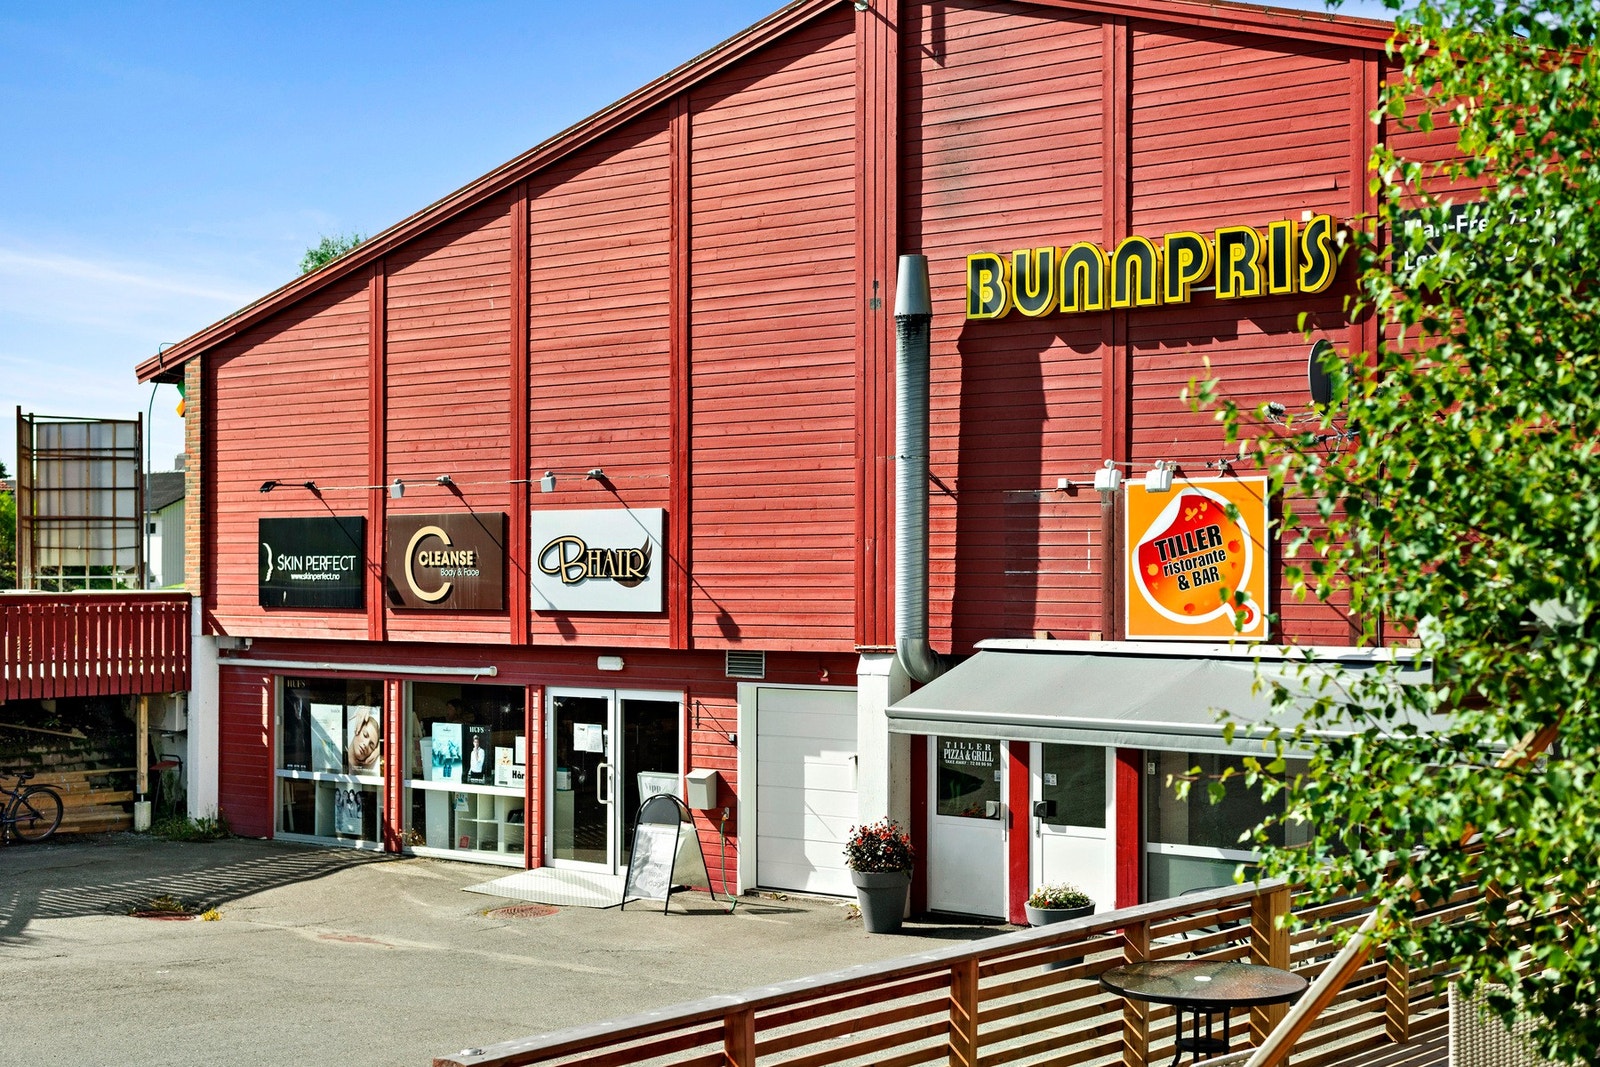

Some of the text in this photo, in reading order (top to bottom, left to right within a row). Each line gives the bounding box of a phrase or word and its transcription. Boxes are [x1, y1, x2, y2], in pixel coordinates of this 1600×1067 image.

[966, 213, 1338, 321] BUNNPRIS
[1153, 523, 1223, 562] TILLER
[277, 553, 356, 571] SKIN PERFECT
[418, 550, 475, 567] CLEANSE
[1162, 549, 1227, 577] ristorante
[290, 572, 341, 581] www.skinperfect.no
[440, 567, 480, 578] Body & Face
[1176, 566, 1221, 592] & BAR
[945, 741, 991, 750] TILLER
[944, 749, 994, 762] PIZZA & GRILL
[512, 769, 525, 780] Hår
